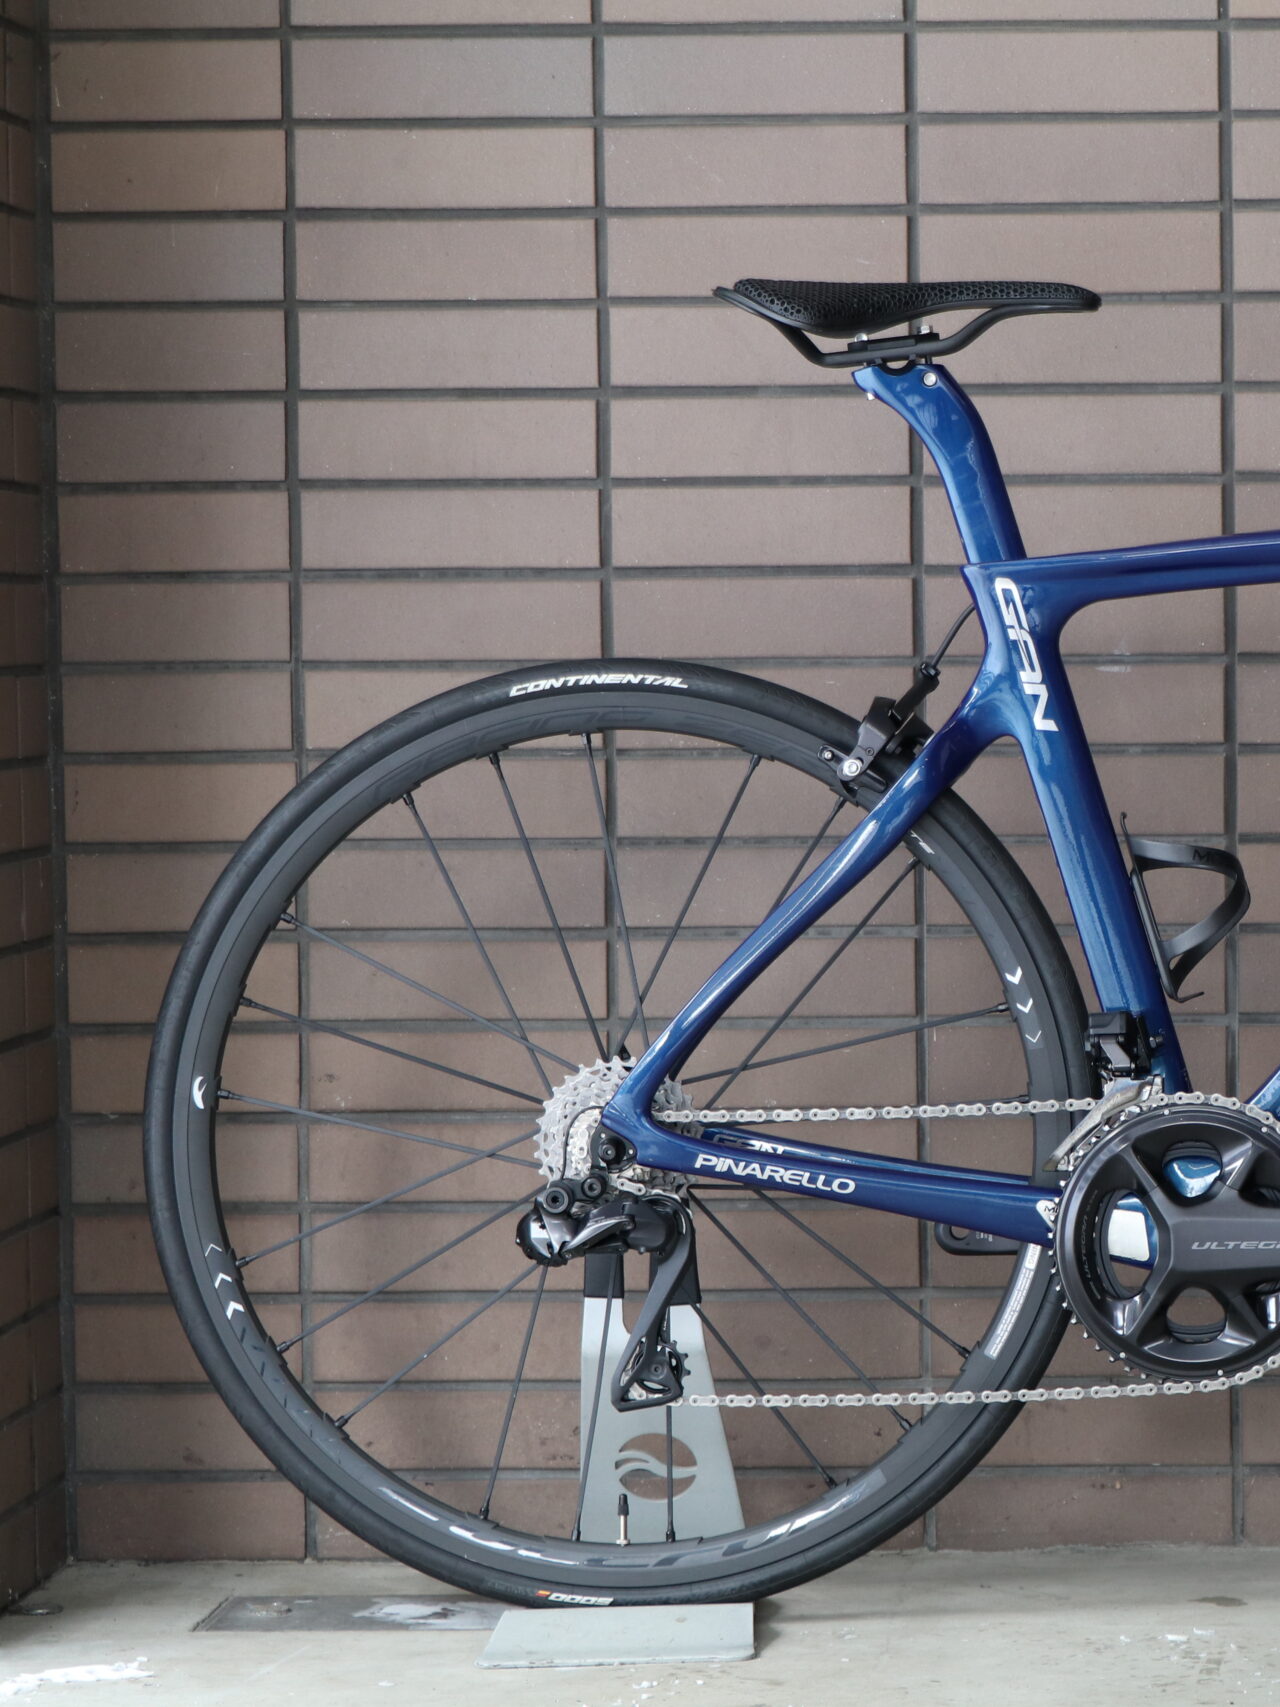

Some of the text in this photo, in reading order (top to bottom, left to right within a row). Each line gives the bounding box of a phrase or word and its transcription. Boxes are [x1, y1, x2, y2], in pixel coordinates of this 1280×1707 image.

[994, 577, 1060, 733] GAN
[508, 672, 689, 698] CONTINENTAL
[694, 1153, 857, 1195] PINARELLO
[547, 1592, 615, 1606] 5000
